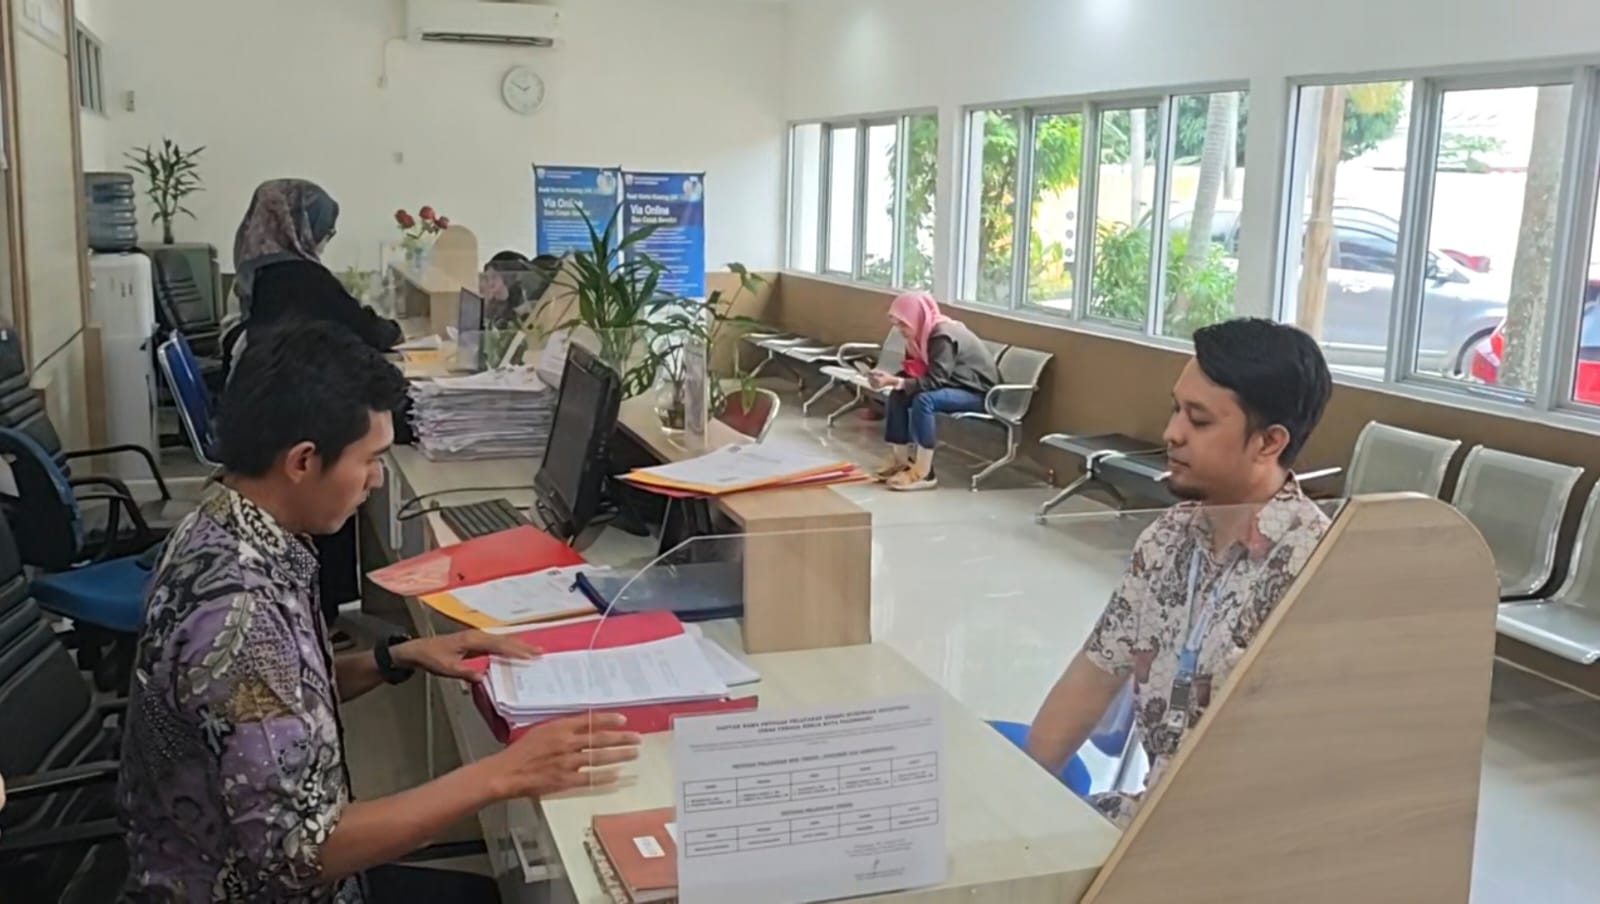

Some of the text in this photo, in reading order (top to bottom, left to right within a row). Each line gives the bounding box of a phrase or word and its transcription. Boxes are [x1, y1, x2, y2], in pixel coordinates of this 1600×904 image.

[542, 198, 556, 208] Via
[630, 204, 669, 216] Via Online
